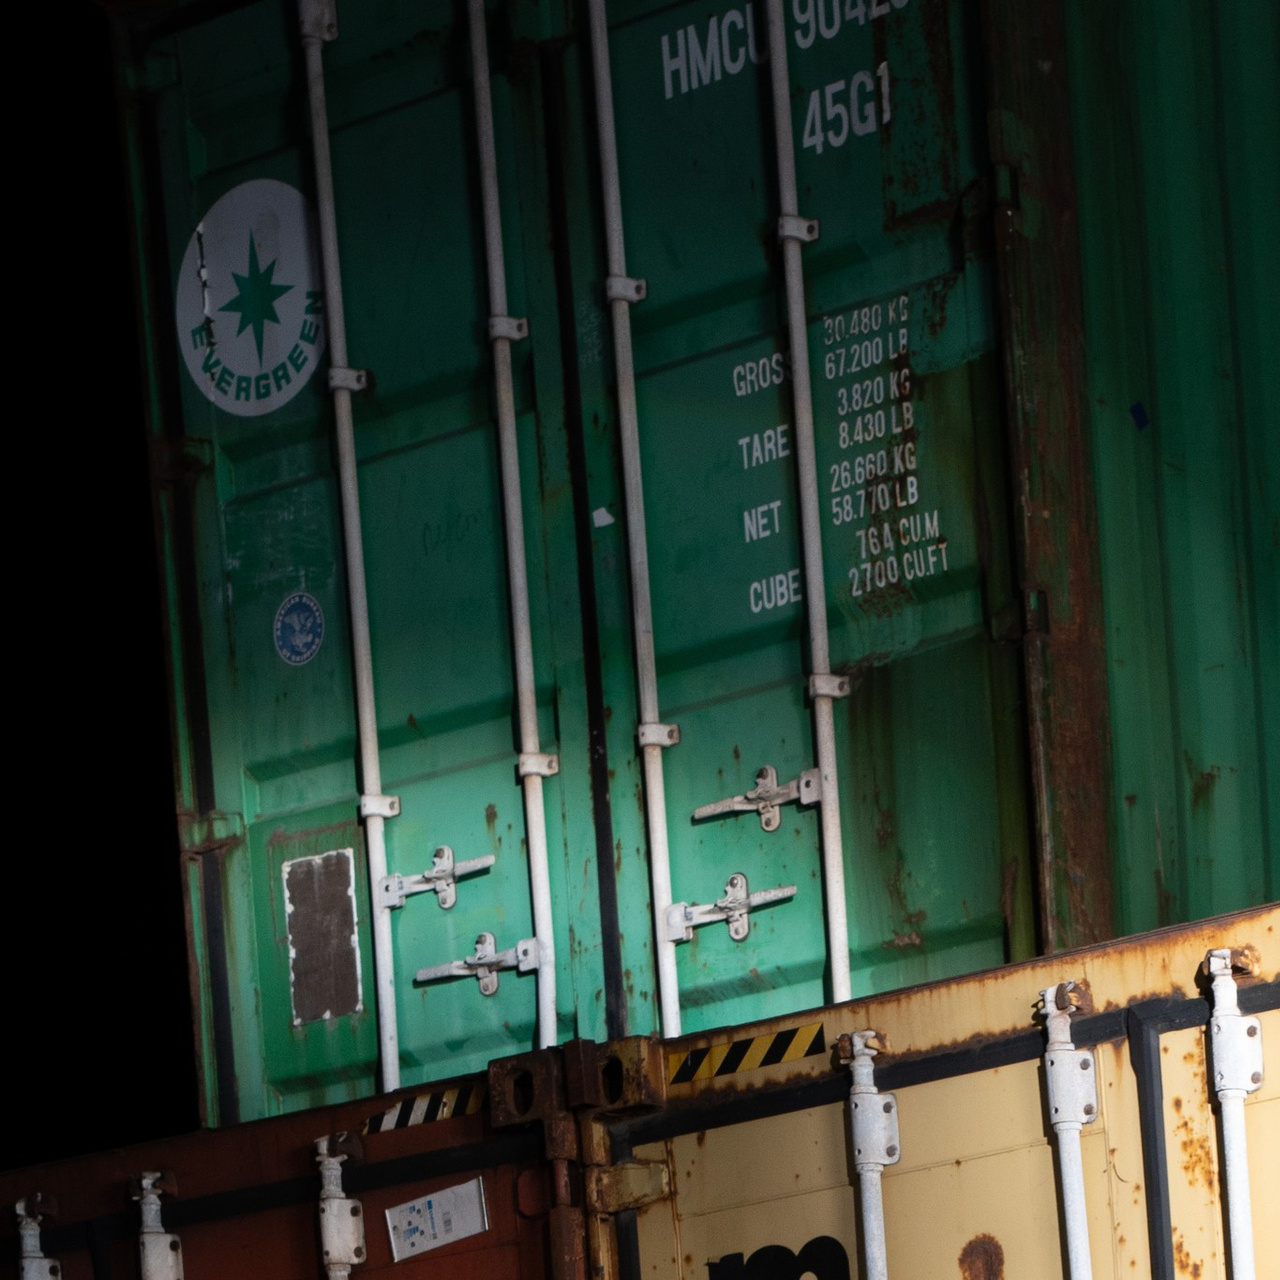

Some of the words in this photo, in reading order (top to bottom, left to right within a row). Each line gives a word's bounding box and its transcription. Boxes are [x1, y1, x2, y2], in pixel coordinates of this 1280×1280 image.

[802, 61, 892, 155] 45G1
[823, 304, 881, 346] 30.480
[888, 295, 909, 325] KG
[190, 290, 324, 402] EVERGREEN
[824, 337, 882, 380] 67.200
[888, 328, 908, 359] LB
[732, 351, 790, 397] GROS
[837, 376, 884, 416] 3.820
[889, 368, 911, 400] KG
[738, 424, 791, 470] TARE
[838, 410, 886, 450] 8.430
[891, 401, 914, 434] LB
[829, 450, 887, 493] 26.660
[893, 442, 916, 475] KG
[743, 500, 782, 543] NET
[831, 483, 889, 526] 58.770
[894, 476, 919, 508] LB
[902, 541, 949, 580] CU.FT
[749, 568, 803, 614] CUBE
